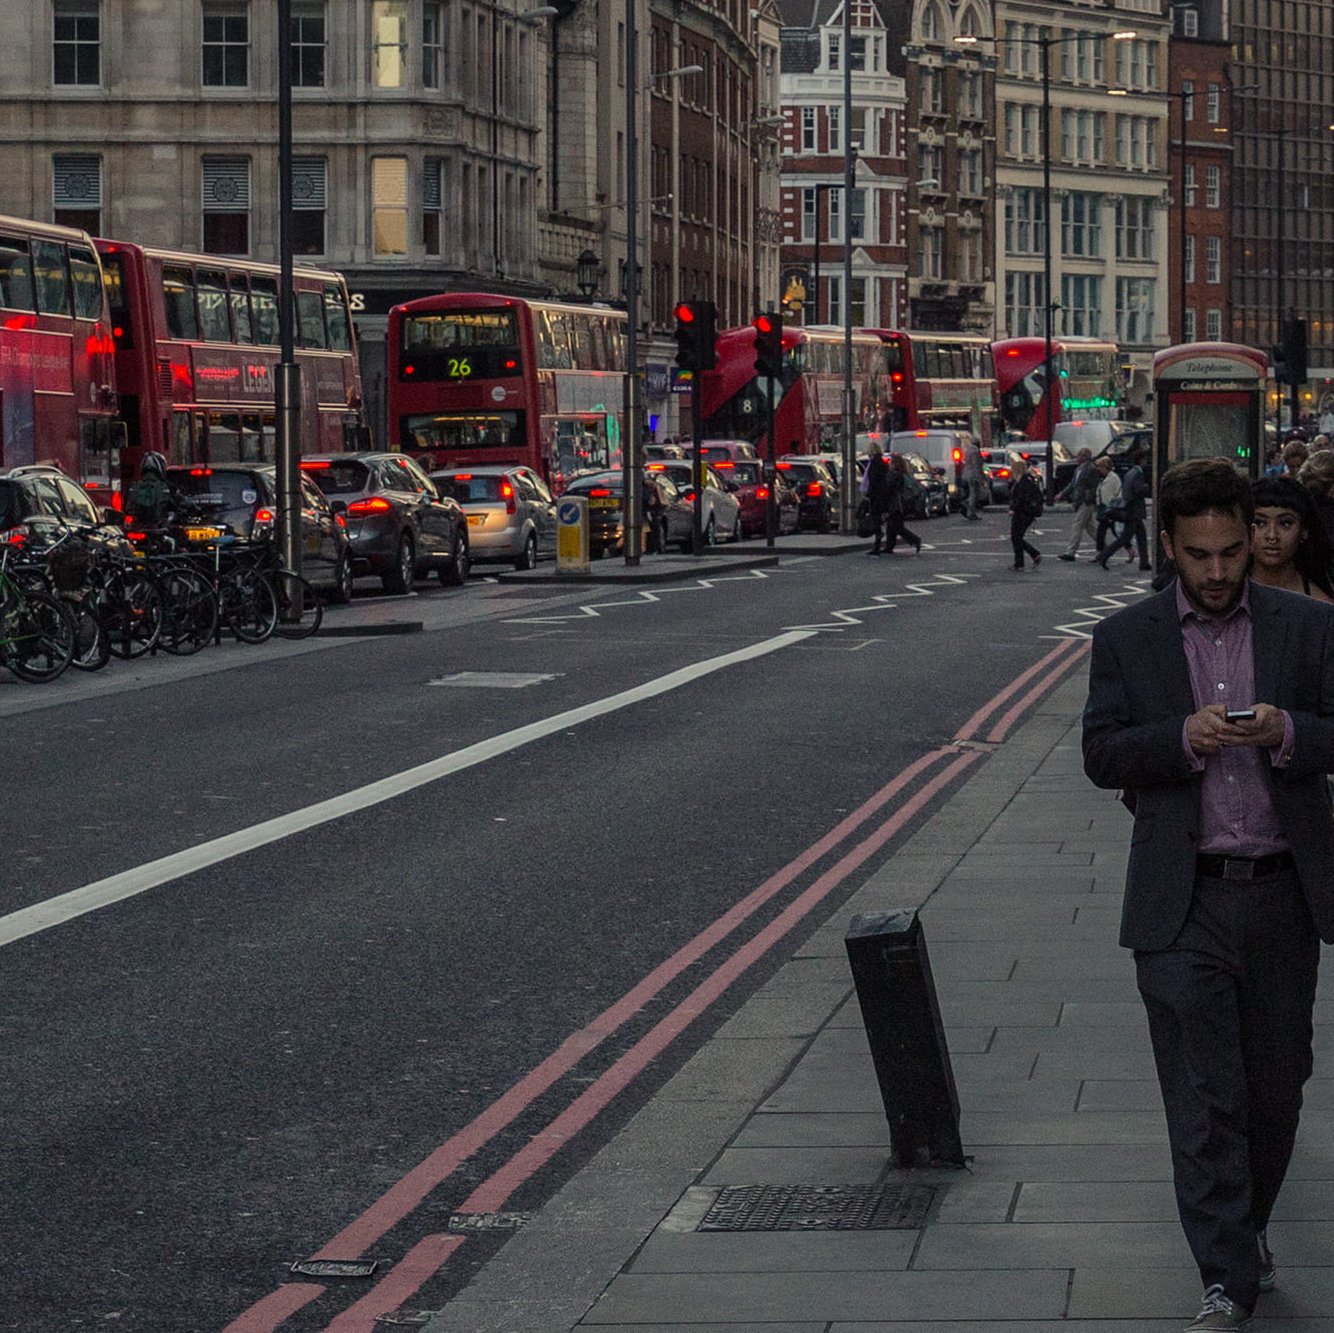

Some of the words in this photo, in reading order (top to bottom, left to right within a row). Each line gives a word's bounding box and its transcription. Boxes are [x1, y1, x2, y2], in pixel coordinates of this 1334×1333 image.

[447, 358, 472, 377] 26
[1187, 362, 1233, 374] Telephone
[242, 365, 276, 393] LEGEN
[1180, 381, 1202, 390] Coins
[742, 398, 753, 414] 8
[1012, 395, 1020, 407] 8
